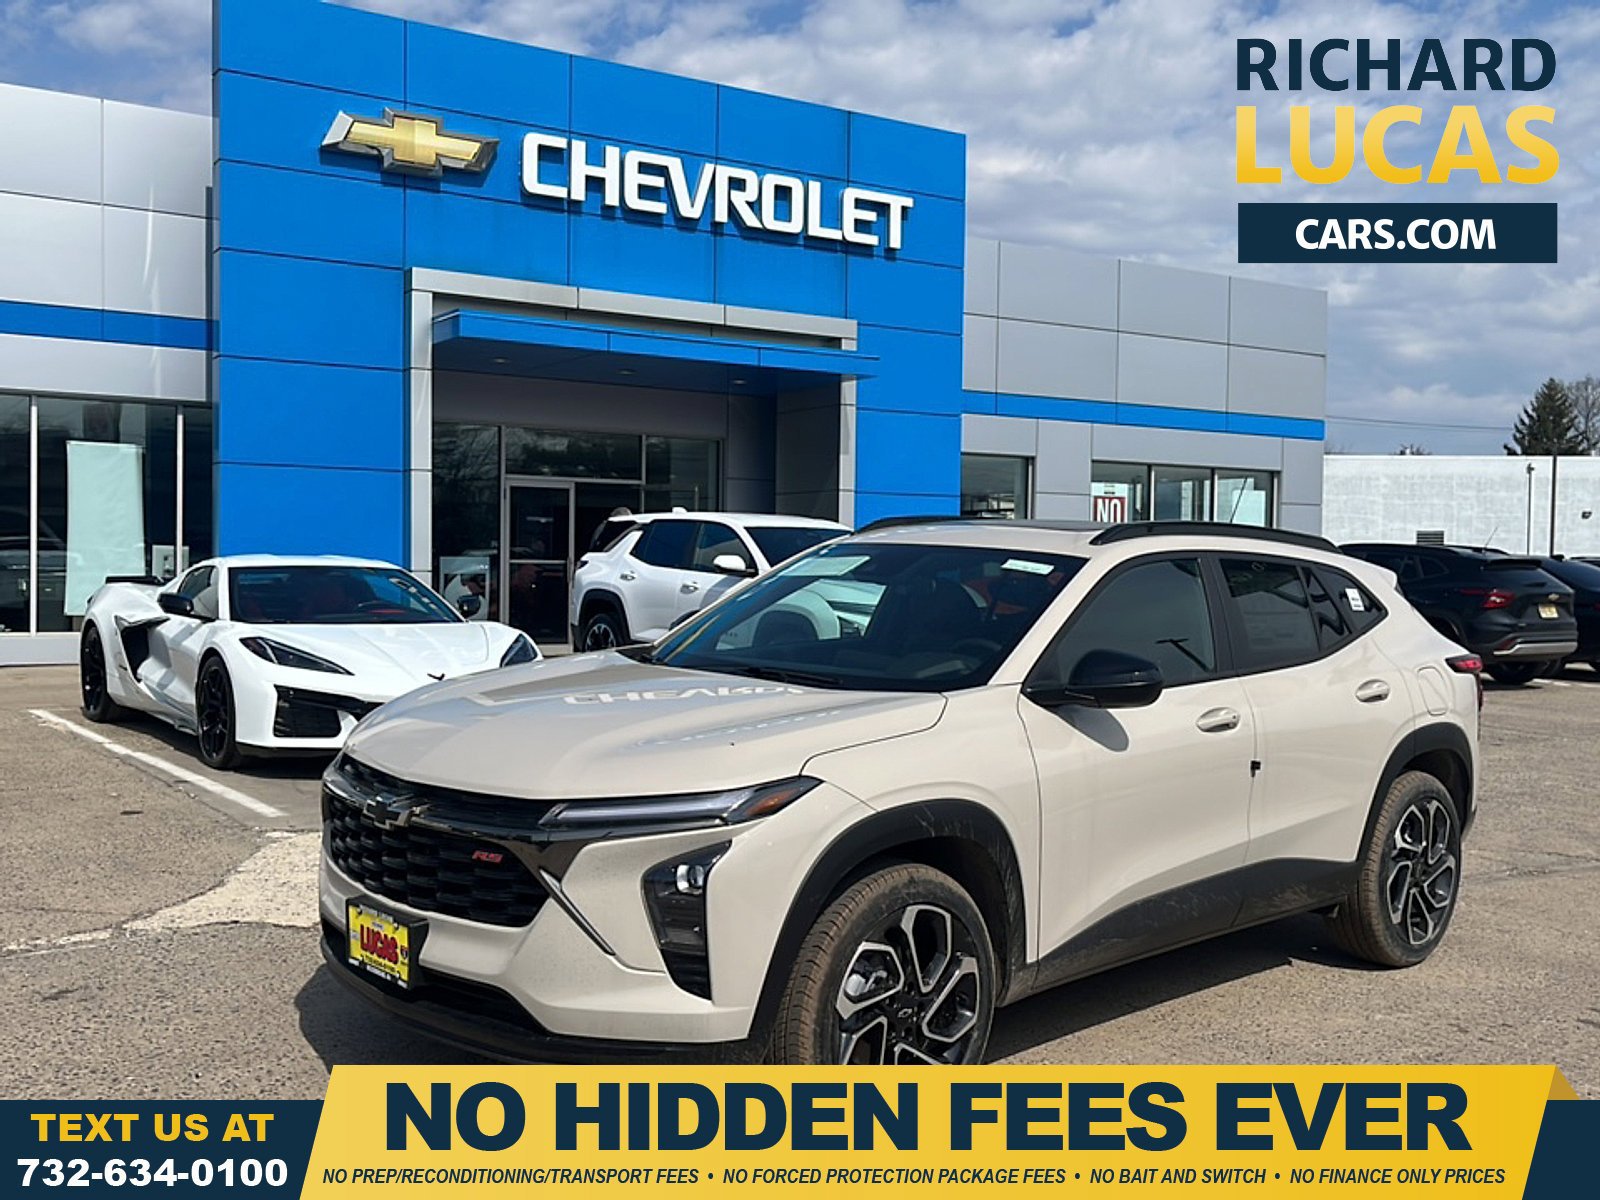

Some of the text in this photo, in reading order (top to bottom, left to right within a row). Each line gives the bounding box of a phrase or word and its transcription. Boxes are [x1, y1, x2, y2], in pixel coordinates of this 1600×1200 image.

[522, 132, 914, 250] CHEVROLET
[1096, 497, 1121, 522] NO
[472, 850, 503, 863] RS
[360, 924, 399, 964] LUCAS
